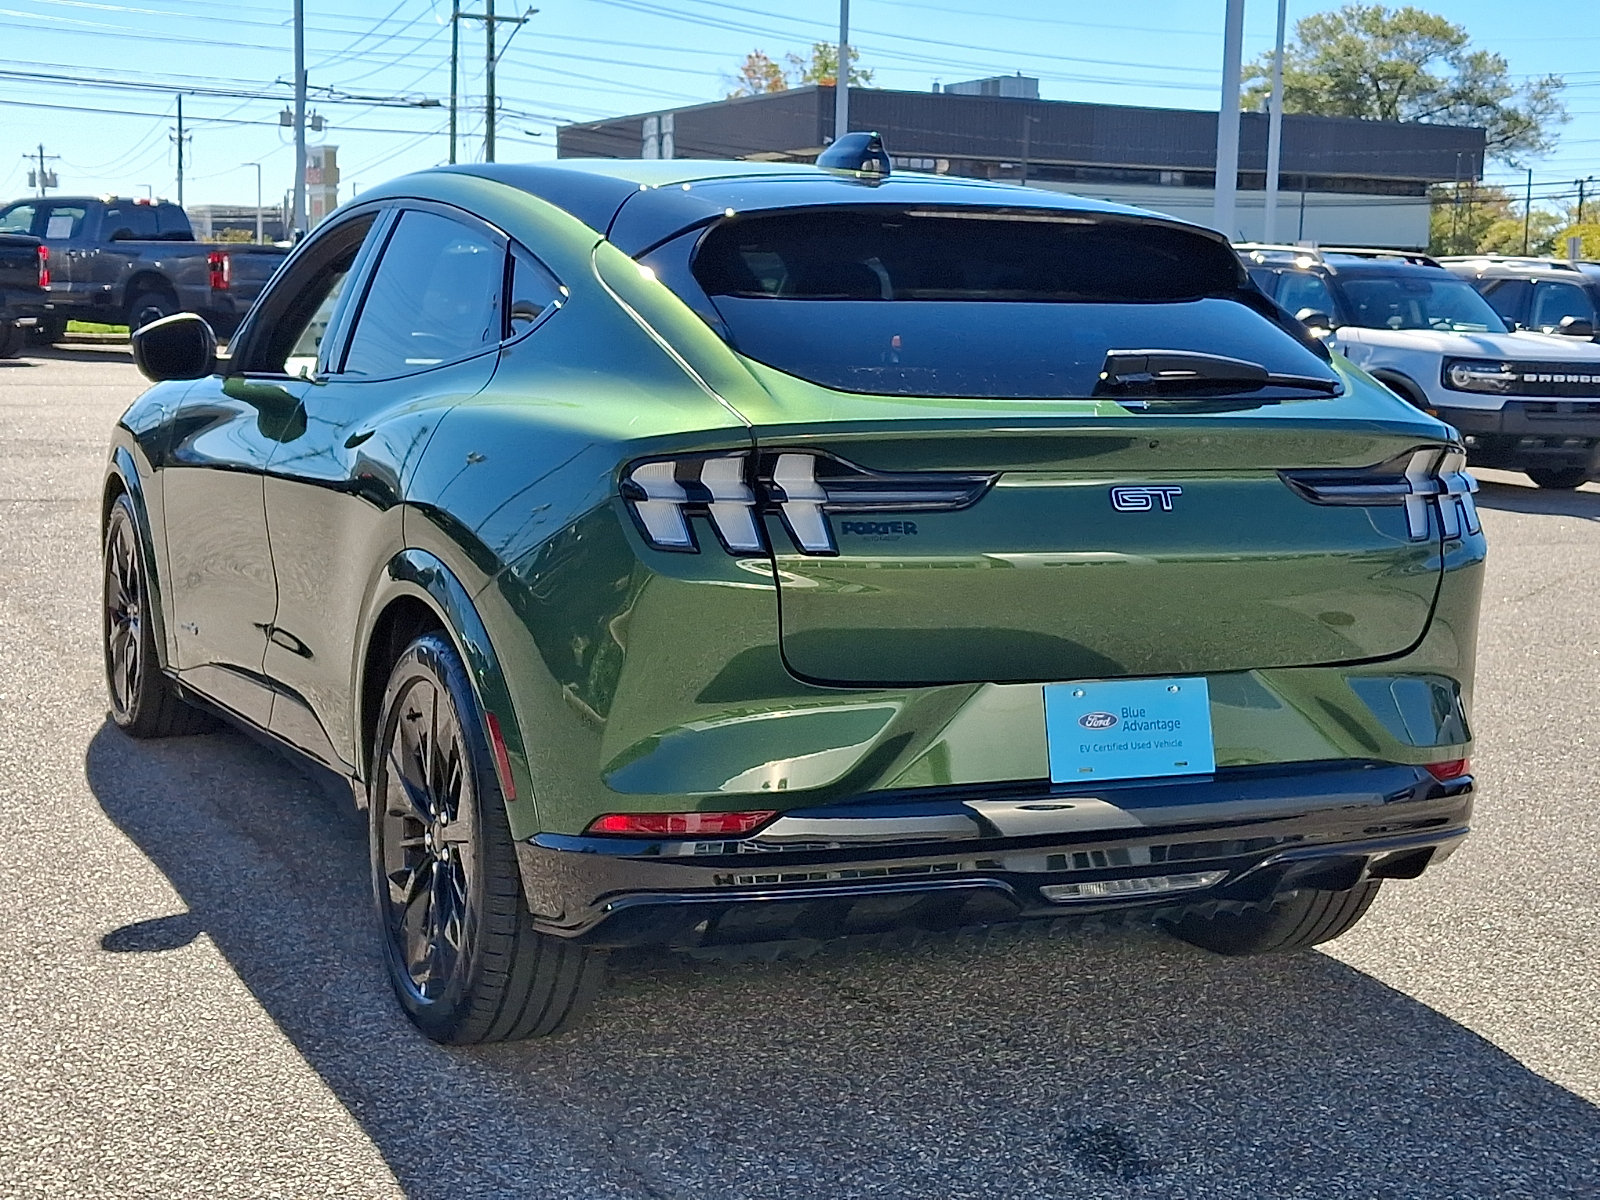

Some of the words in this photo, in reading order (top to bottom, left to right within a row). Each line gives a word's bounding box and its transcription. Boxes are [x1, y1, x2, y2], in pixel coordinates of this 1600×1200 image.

[1110, 485, 1183, 511] GT
[840, 521, 918, 535] PORTER
[1121, 706, 1146, 719] Blue
[1084, 714, 1113, 728] Ford
[1122, 719, 1181, 732] Advantage
[1079, 744, 1091, 753] EV
[1093, 742, 1129, 752] Certified
[1131, 740, 1152, 750] Used
[1153, 739, 1183, 749] Vehicle
